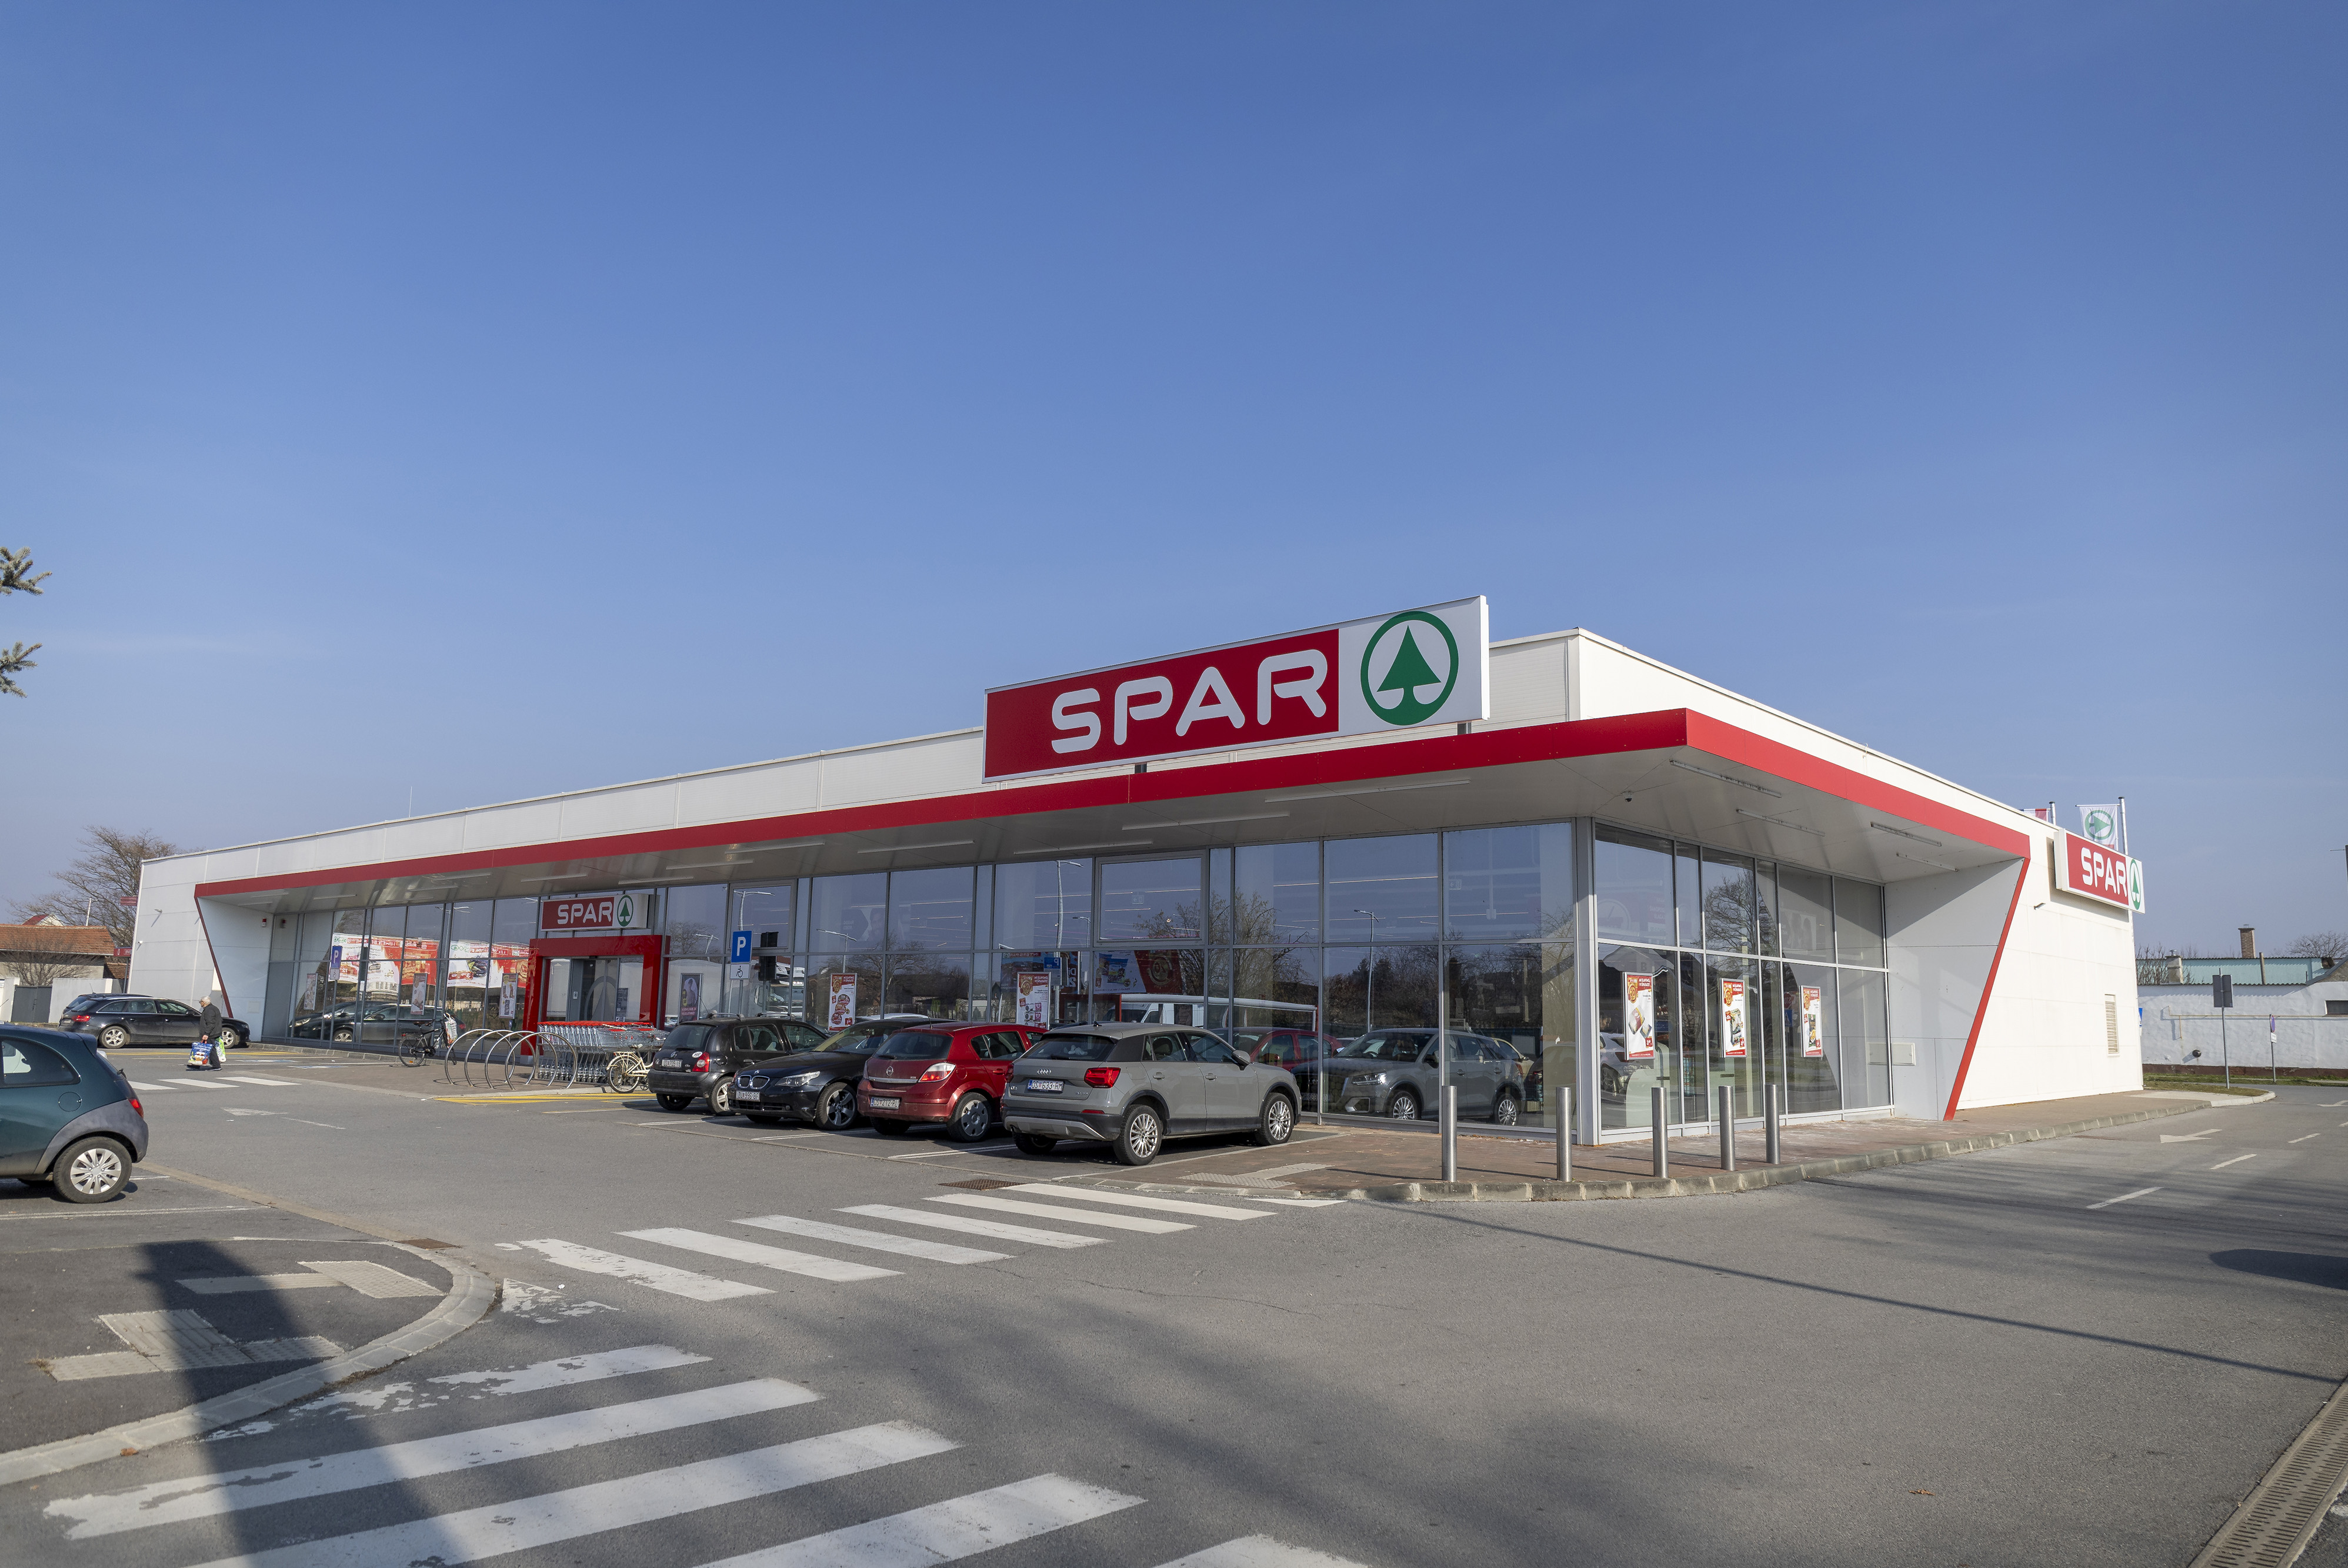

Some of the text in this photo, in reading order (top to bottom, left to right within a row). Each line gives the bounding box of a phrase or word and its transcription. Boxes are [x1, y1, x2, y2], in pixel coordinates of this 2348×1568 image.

[1051, 649, 1328, 754] SPAR
[2081, 847, 2127, 898] SPAR
[557, 901, 613, 925] SPAR
[333, 950, 339, 963] P
[736, 936, 746, 956] P
